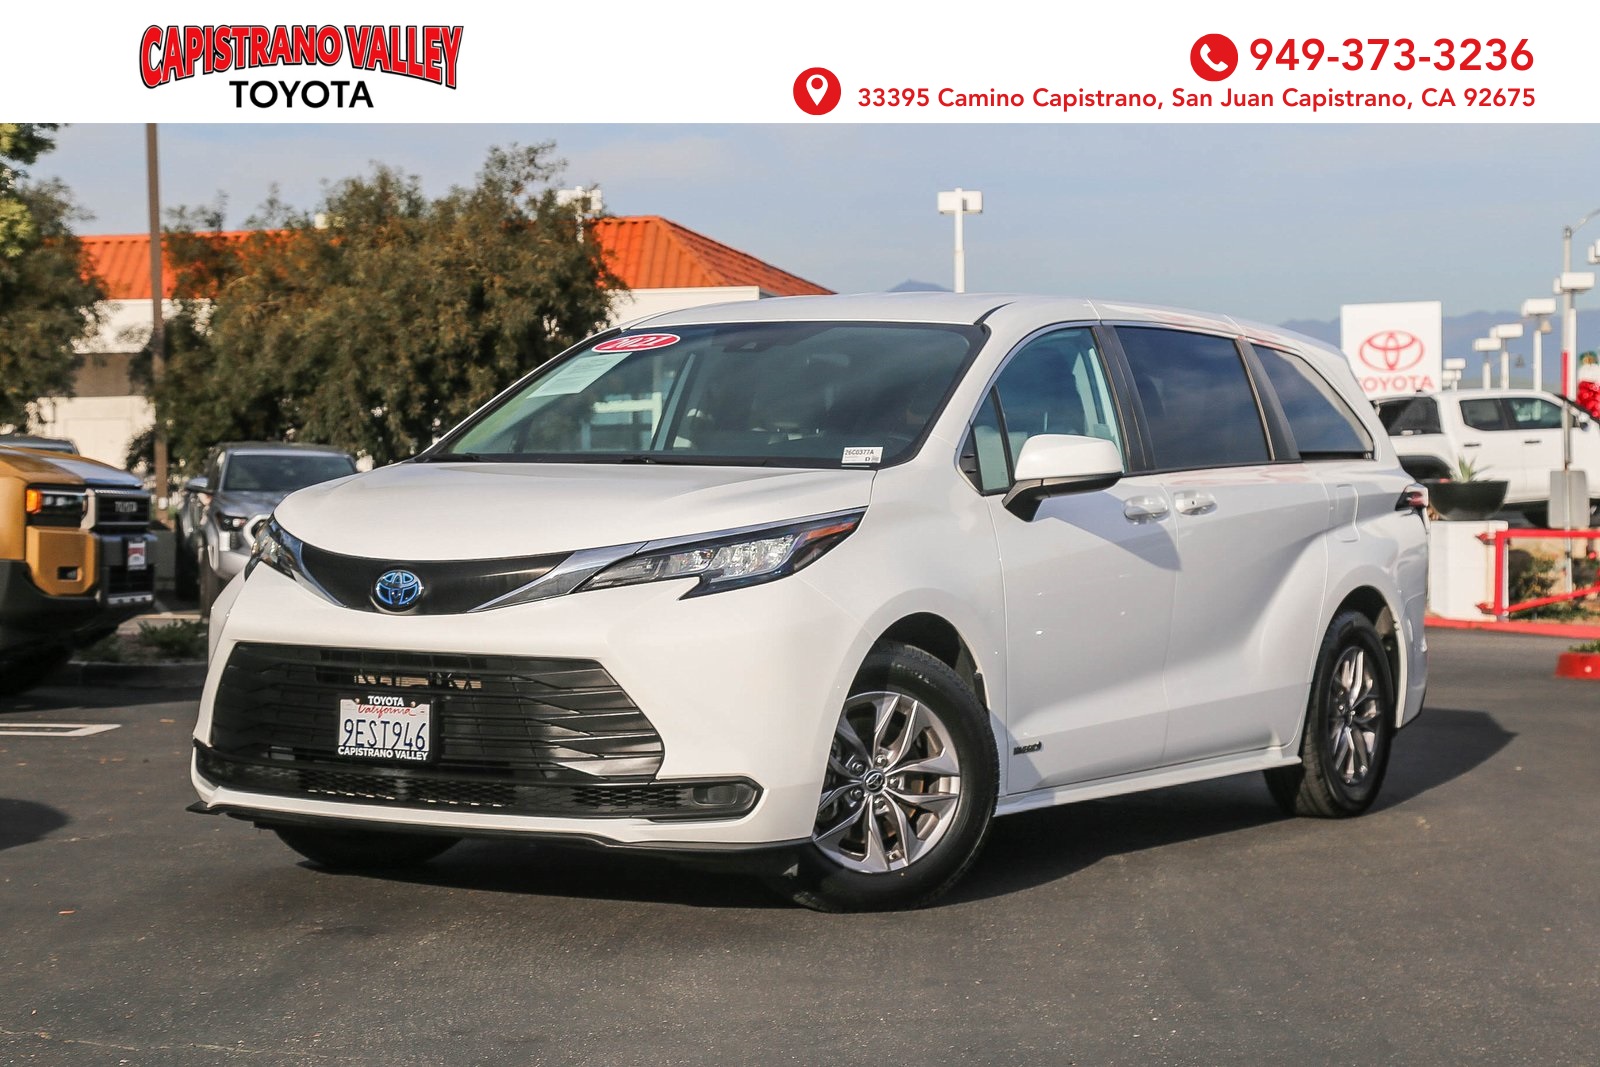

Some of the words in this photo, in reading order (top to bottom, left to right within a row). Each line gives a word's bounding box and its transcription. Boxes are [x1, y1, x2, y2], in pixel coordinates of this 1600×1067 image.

[1358, 375, 1434, 392] OYOTA
[367, 695, 405, 707] TOYOTA
[358, 704, 416, 718] California
[344, 718, 427, 751] 9EST946
[338, 746, 393, 758] CAPISTRANO
[395, 749, 428, 761] VALLEY
